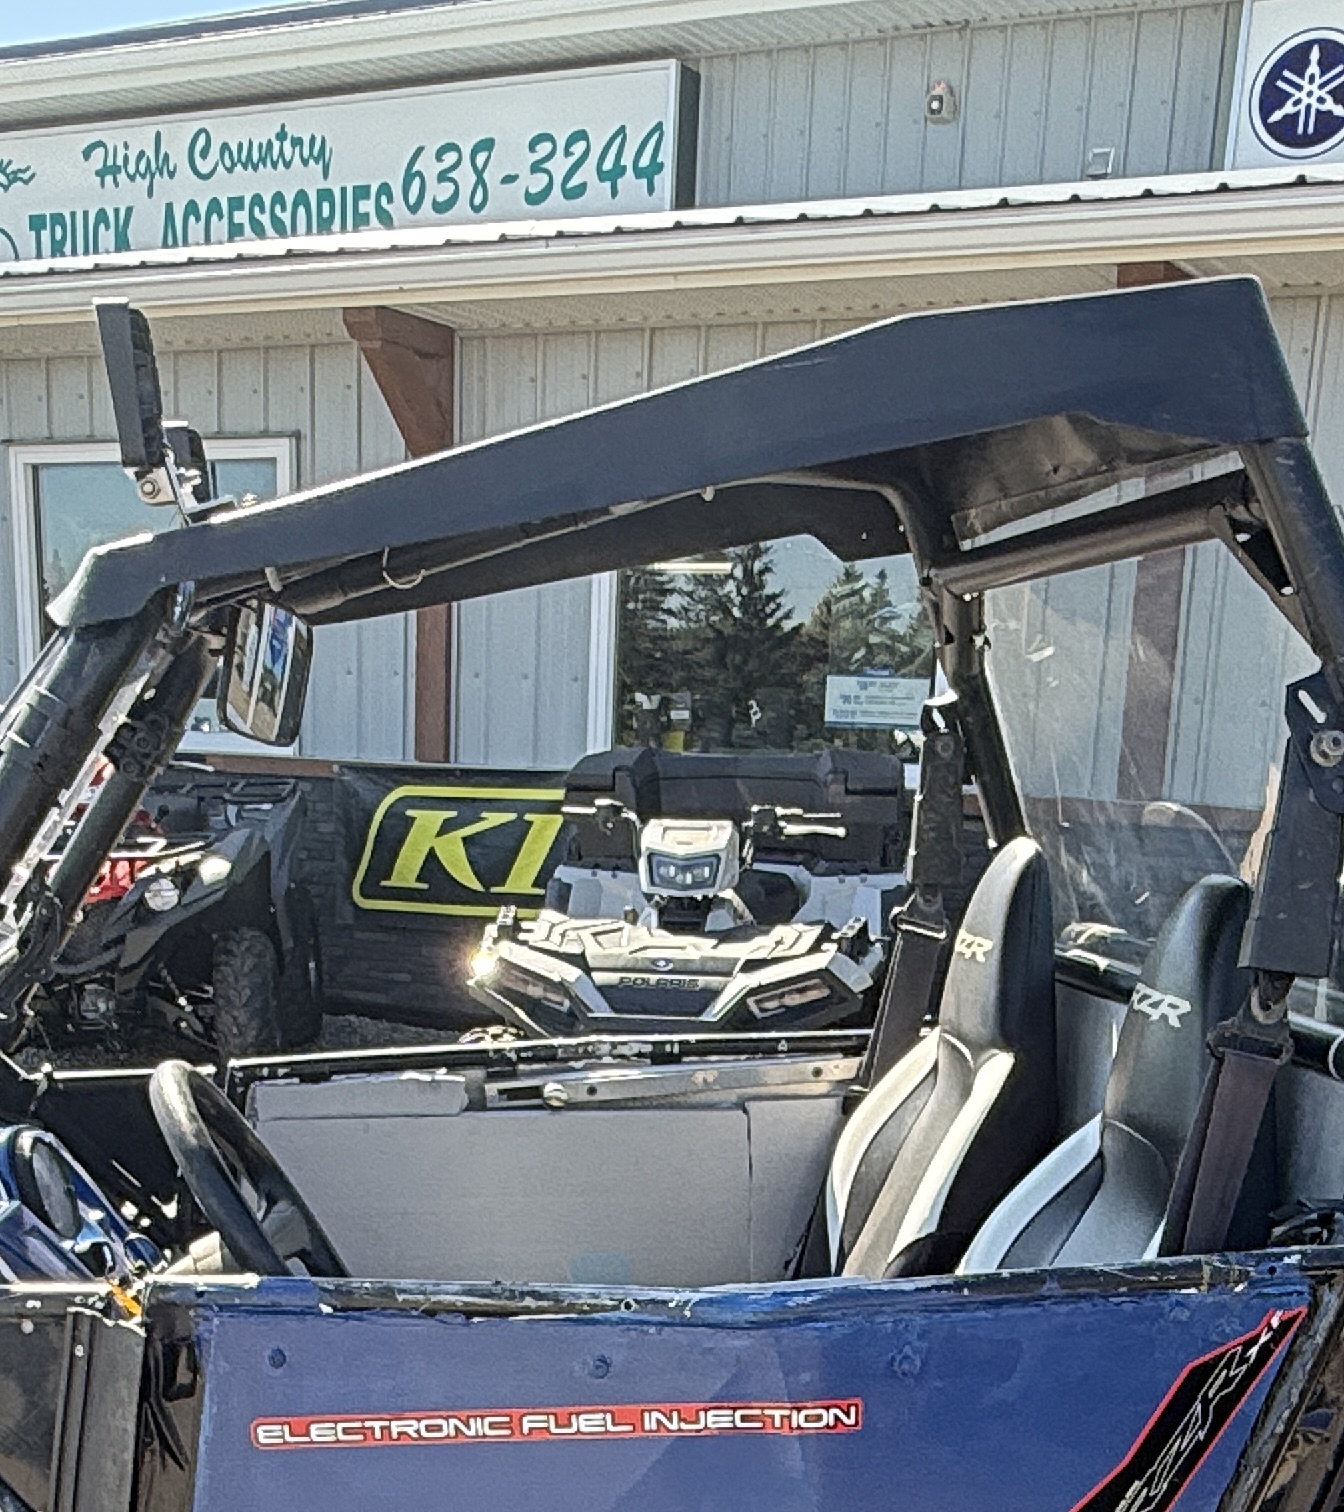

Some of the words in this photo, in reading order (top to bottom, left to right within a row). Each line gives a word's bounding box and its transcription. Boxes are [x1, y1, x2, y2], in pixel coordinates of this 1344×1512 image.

[82, 130, 177, 199] High
[188, 123, 333, 182] Country
[402, 120, 665, 216] 638-3244
[28, 205, 134, 260] TRUCK
[161, 181, 394, 249] ACCESSORIES
[618, 977, 700, 991] POLARIS
[255, 1415, 514, 1445] ELECTRONIC
[520, 1411, 634, 1437] FUEL
[643, 1405, 857, 1431] INJECTION
